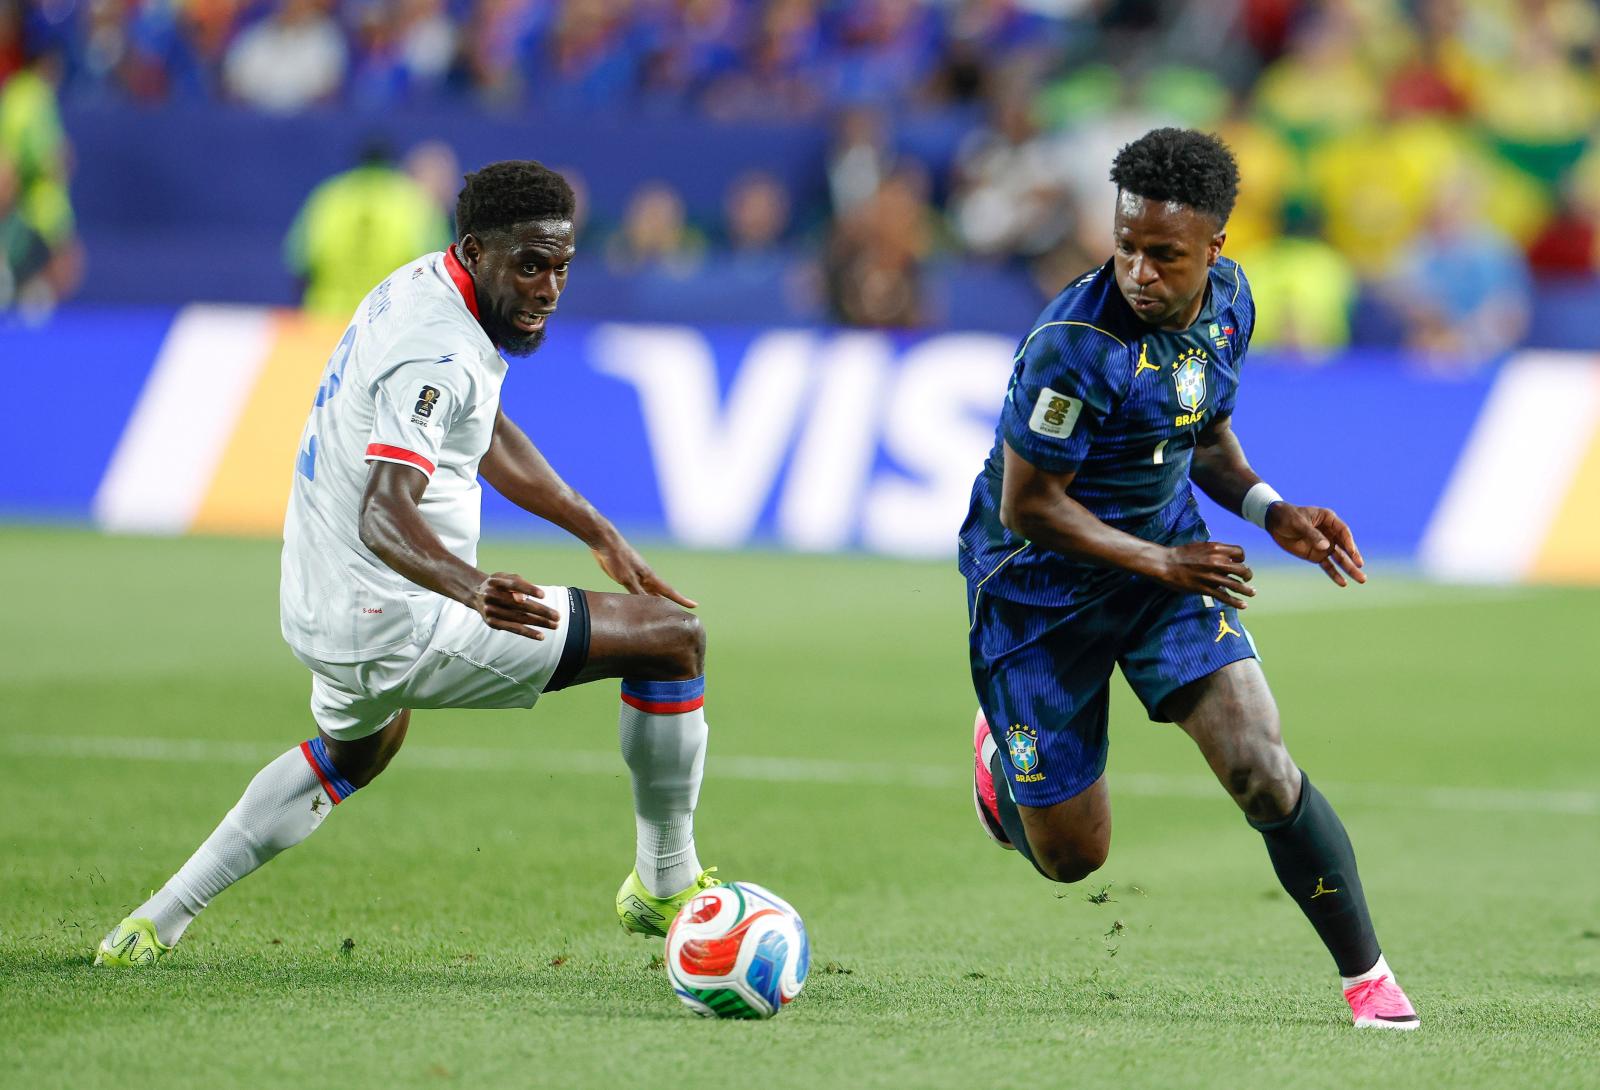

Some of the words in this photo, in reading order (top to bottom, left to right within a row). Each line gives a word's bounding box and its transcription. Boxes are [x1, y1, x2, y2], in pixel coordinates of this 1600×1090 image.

[1175, 408, 1207, 427] BRAS
[588, 324, 1008, 559] VIS
[1015, 772, 1046, 783] BRASIL
